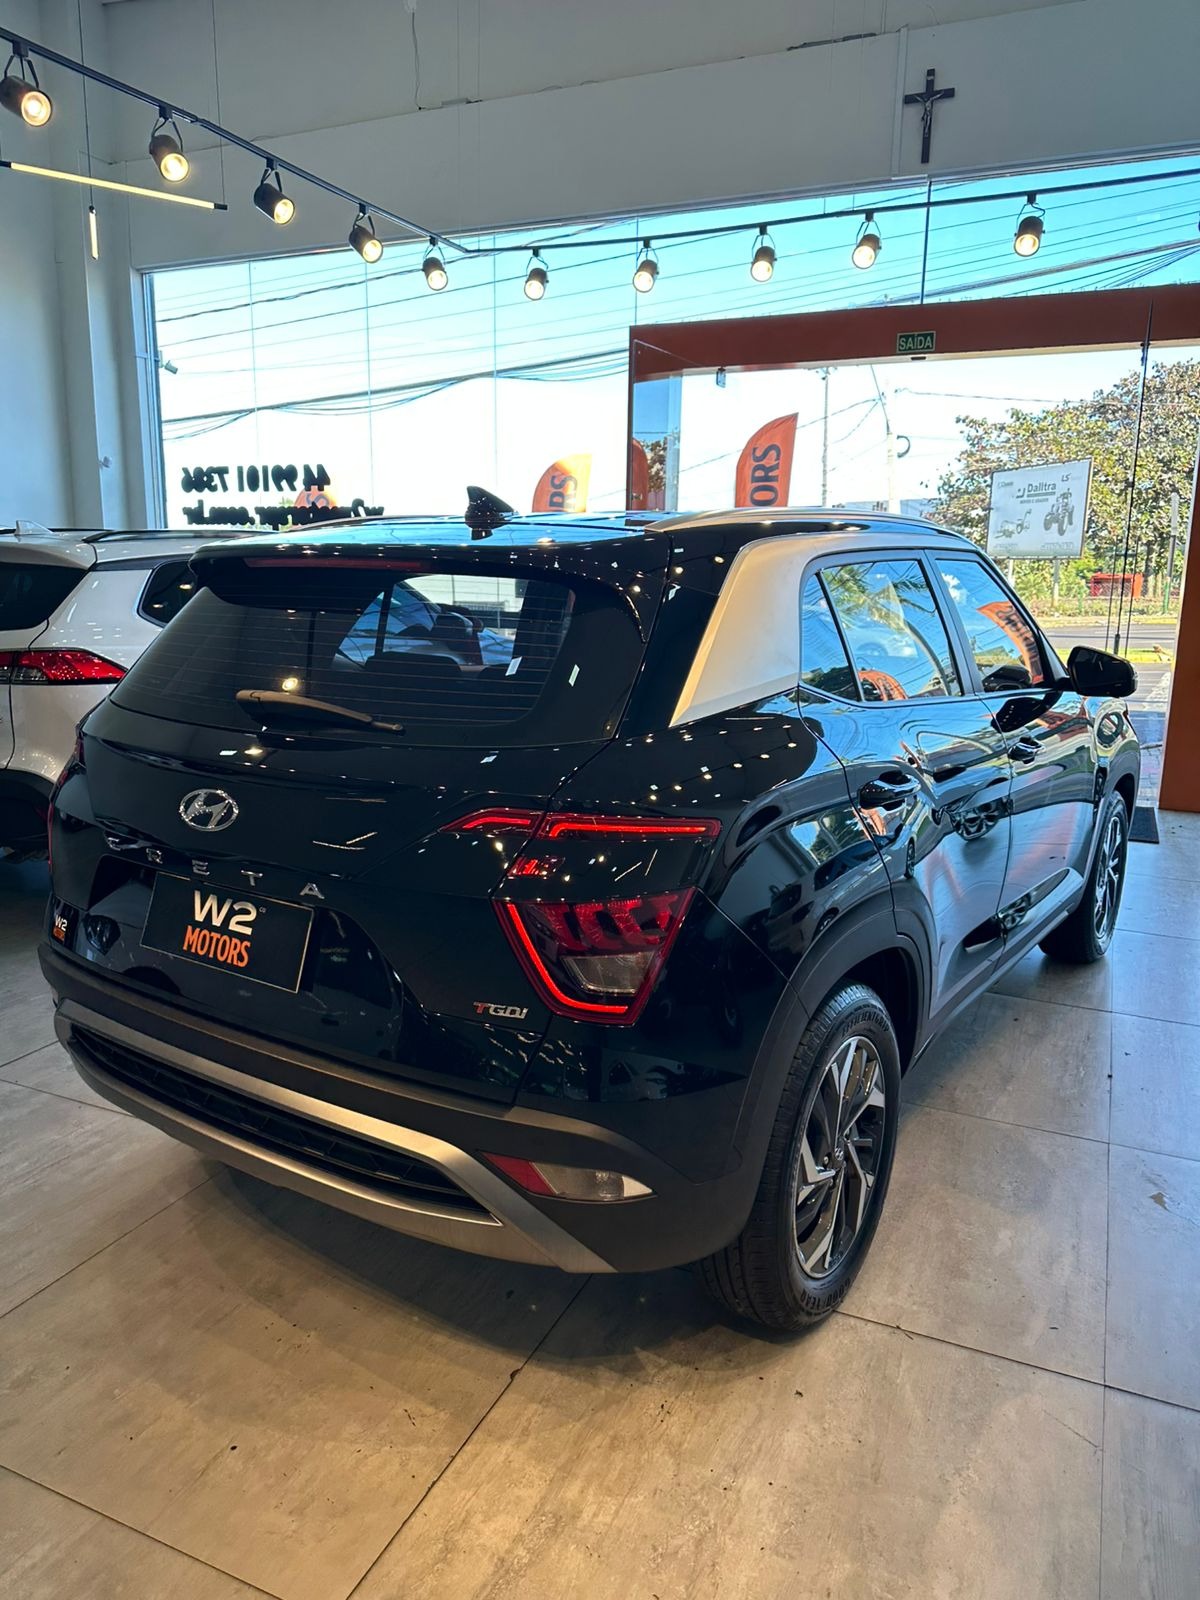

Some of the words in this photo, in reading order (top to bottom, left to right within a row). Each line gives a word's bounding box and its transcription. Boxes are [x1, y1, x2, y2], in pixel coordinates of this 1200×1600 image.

[899, 333, 933, 350] SAÍDA
[548, 473, 578, 512] RS
[107, 836, 325, 899] CRETA
[55, 914, 68, 931] W2
[193, 889, 258, 936] W2
[182, 924, 251, 968] MOTORS
